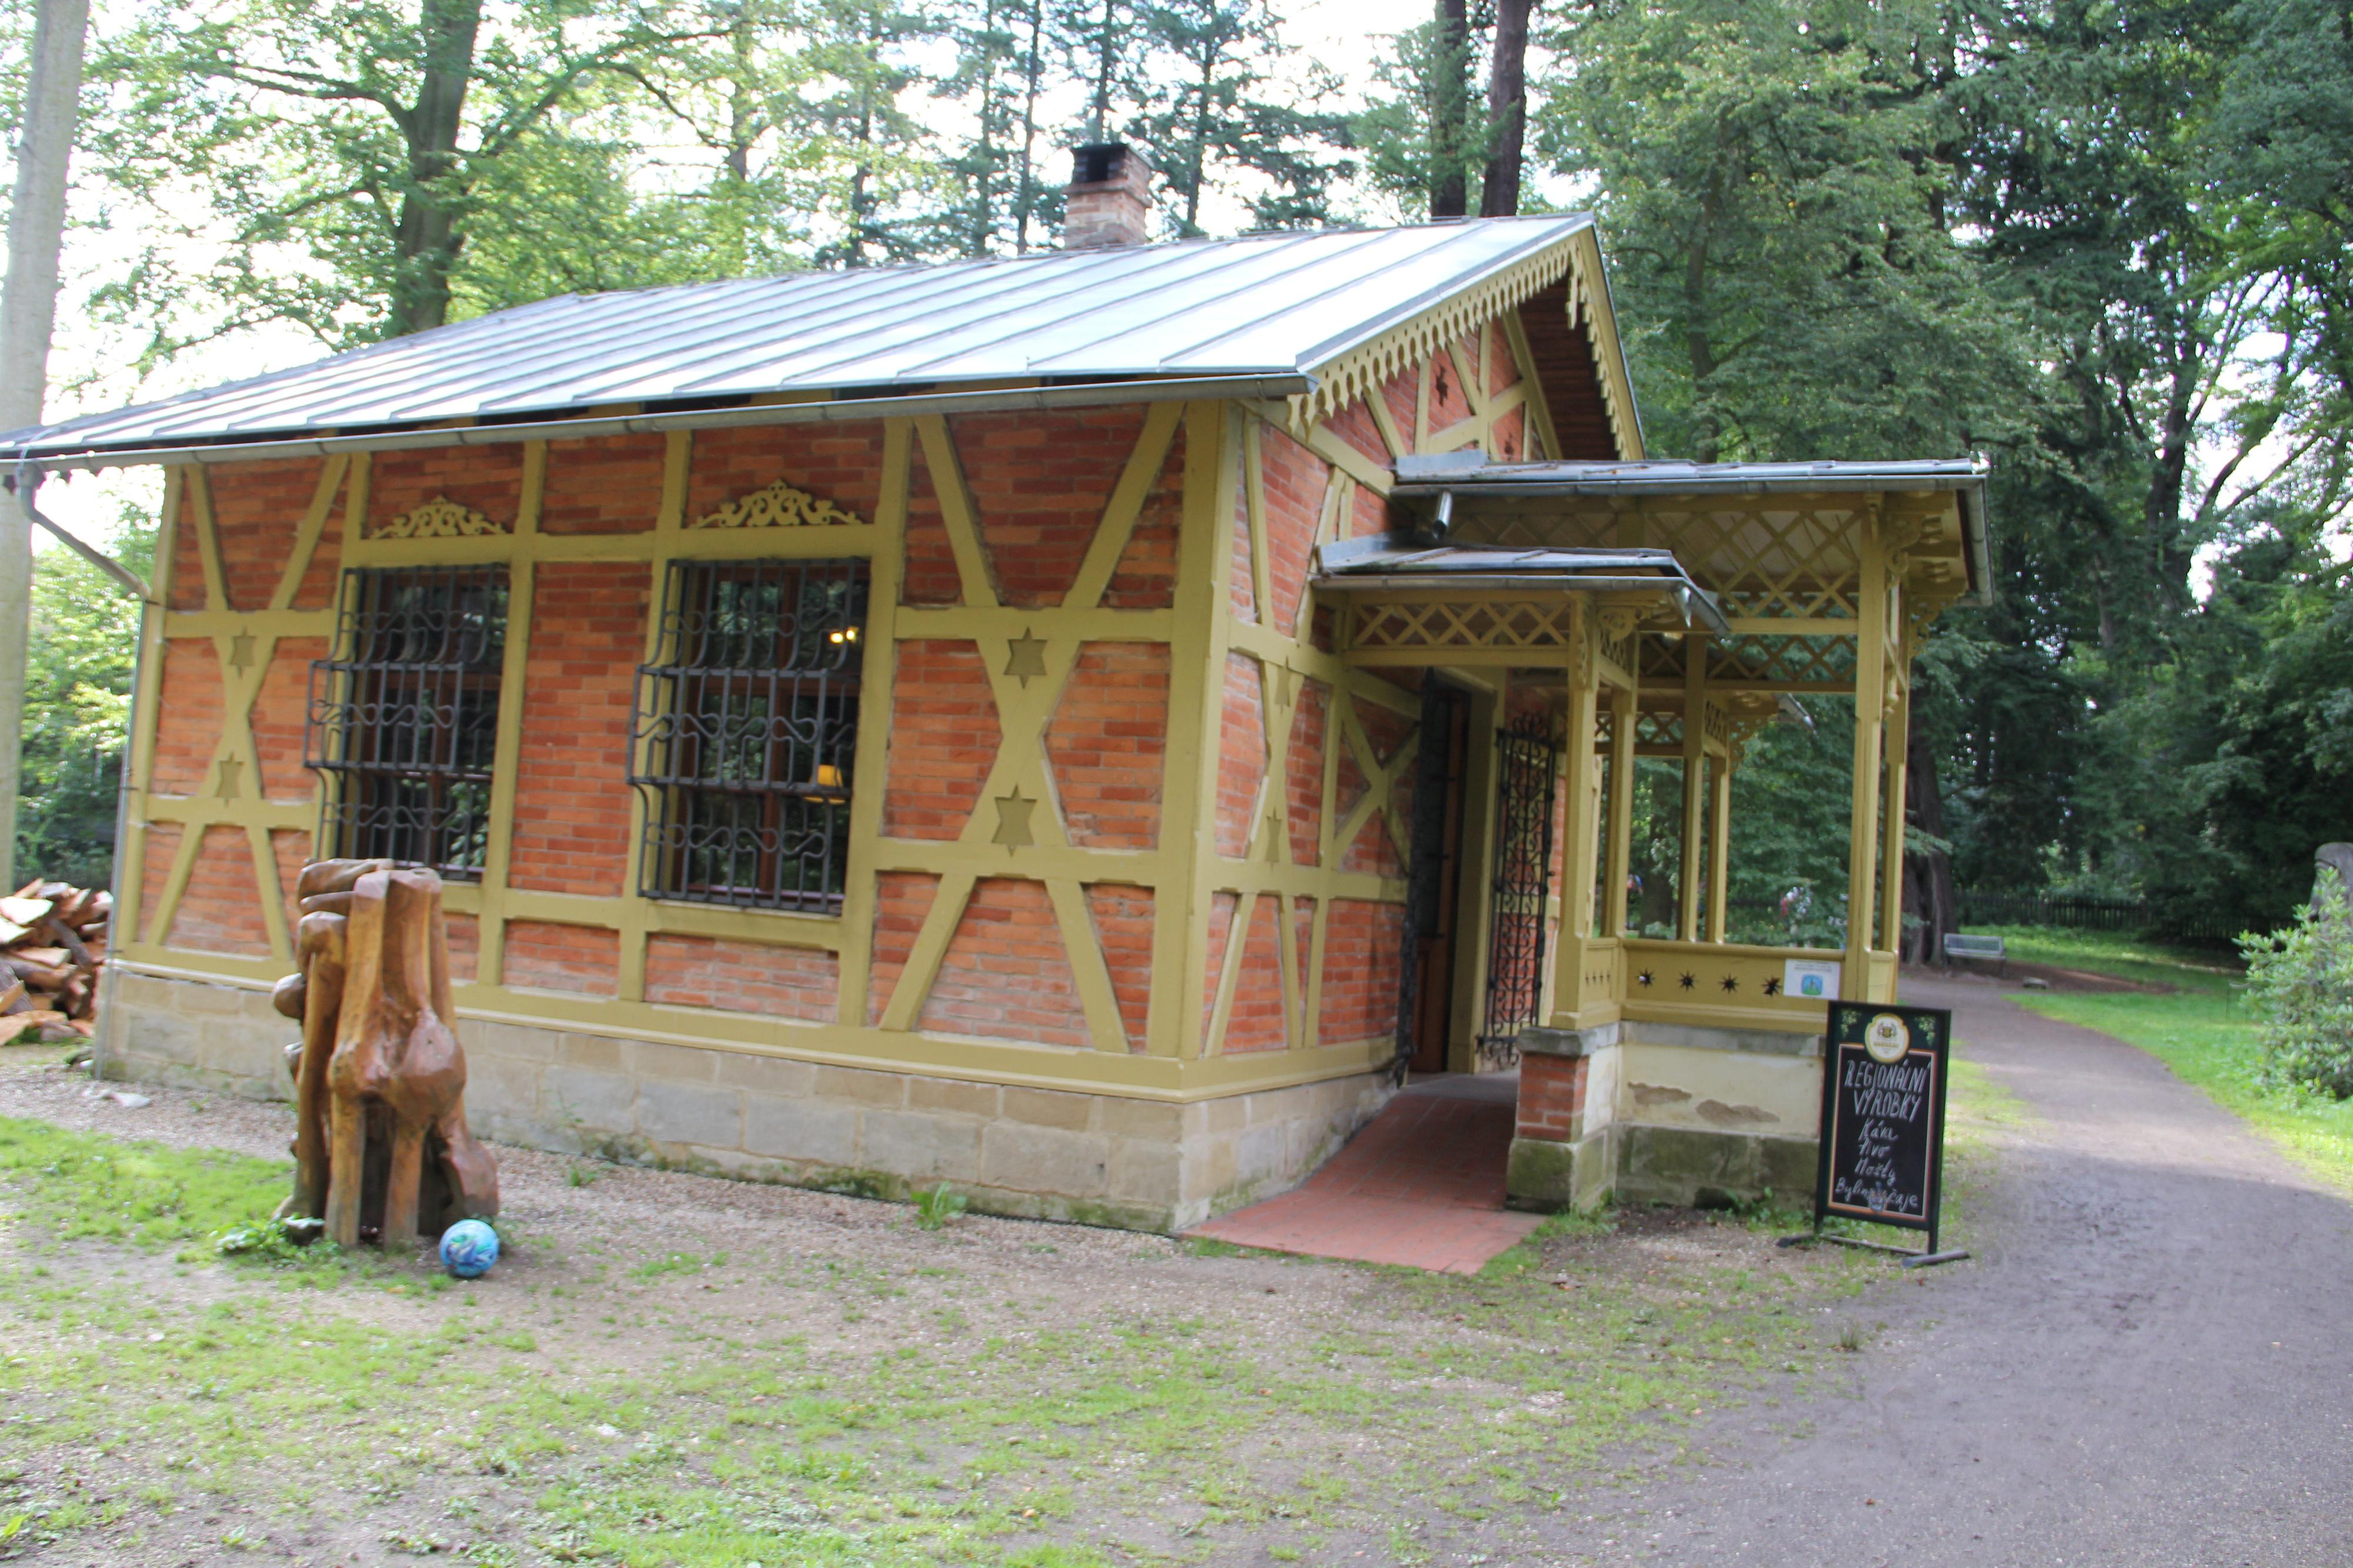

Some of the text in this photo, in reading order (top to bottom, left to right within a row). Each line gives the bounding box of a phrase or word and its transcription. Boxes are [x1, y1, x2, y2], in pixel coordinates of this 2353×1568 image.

[1844, 1059, 1931, 1094] REGIONÁLNÍ
[1858, 1117, 1899, 1141] Káva
[1859, 1136, 1891, 1157] Pivo
[1854, 1157, 1897, 1186] Mošty
